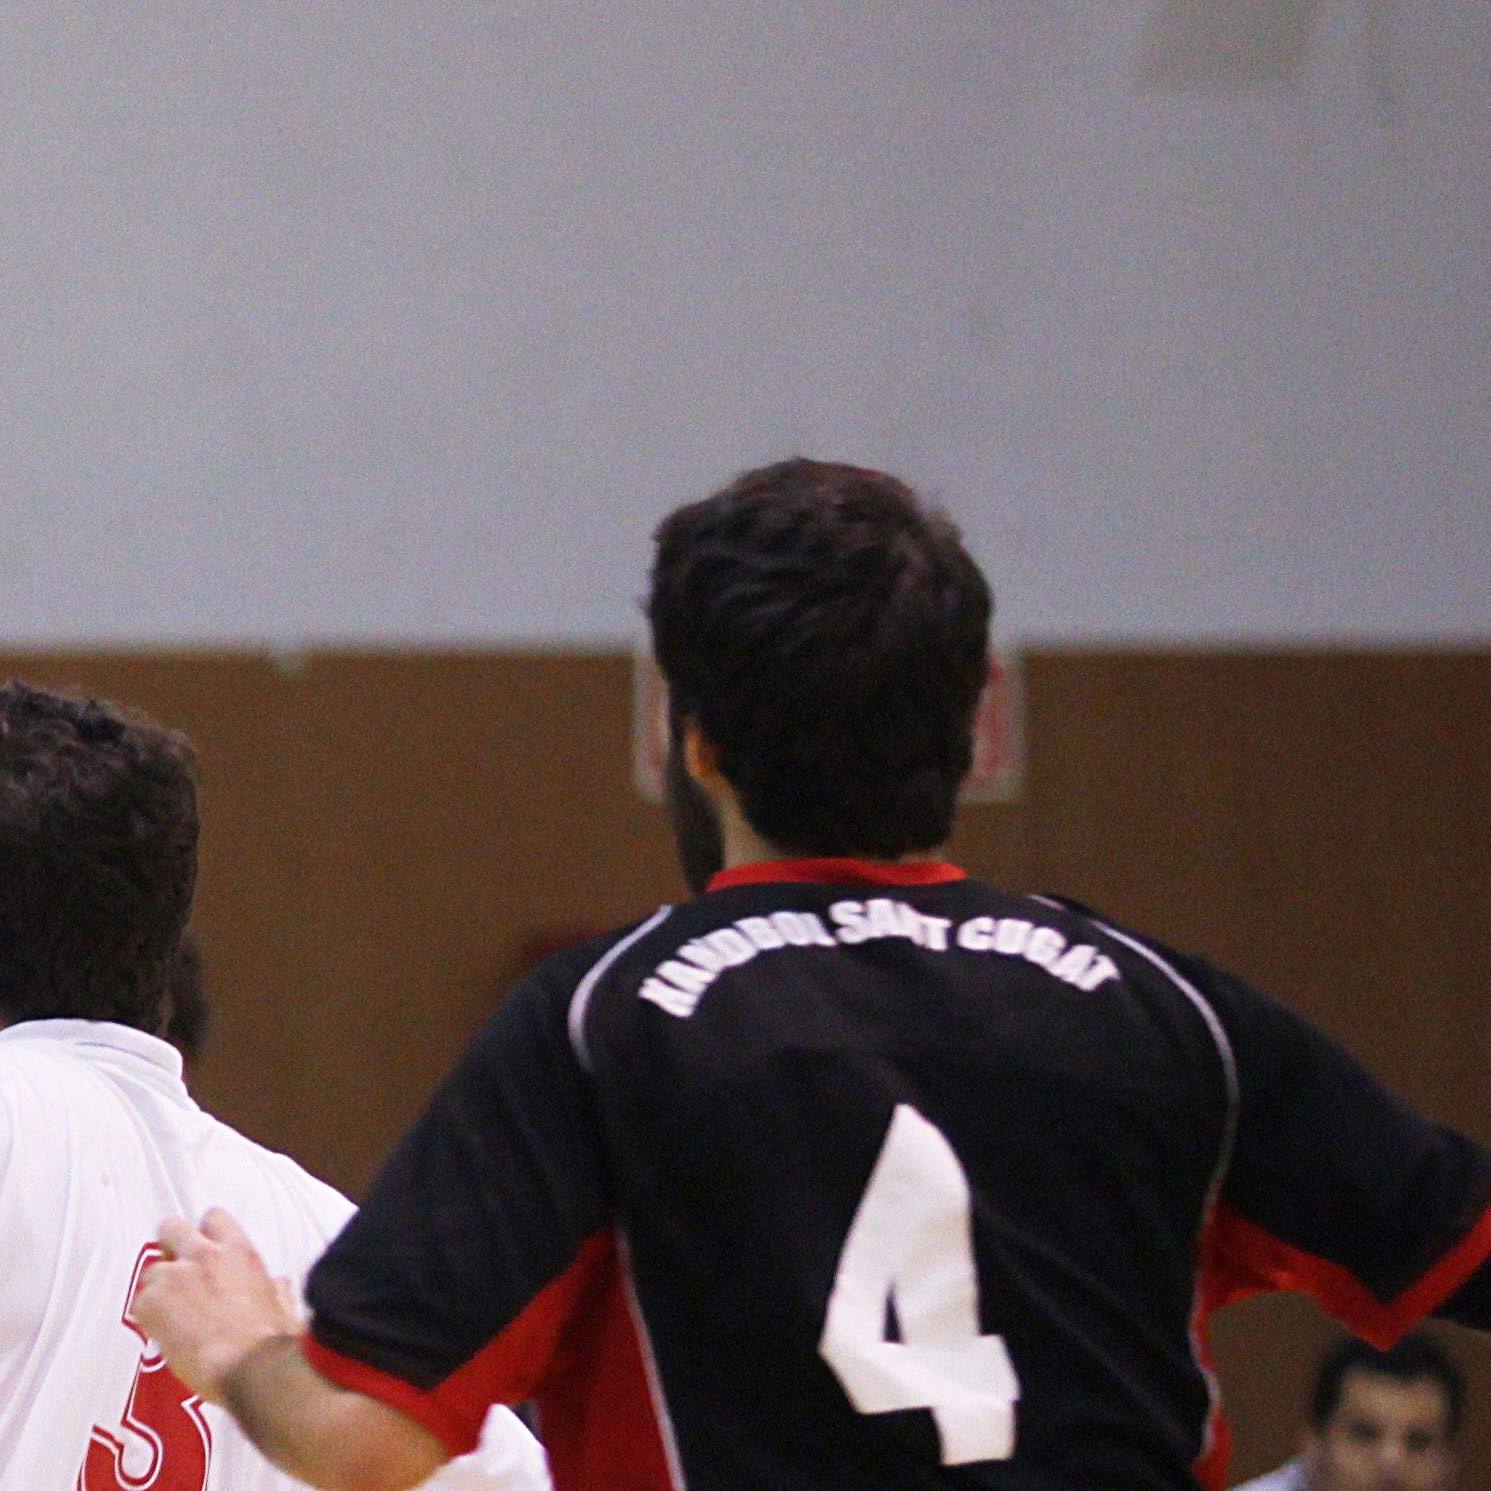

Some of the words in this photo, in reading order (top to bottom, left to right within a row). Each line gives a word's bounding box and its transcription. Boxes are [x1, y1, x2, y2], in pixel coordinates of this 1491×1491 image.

[638, 911, 838, 1018] HANDBOL
[828, 897, 952, 955] SANT
[956, 916, 1122, 991] CUGAT
[819, 1103, 1019, 1466] 4
